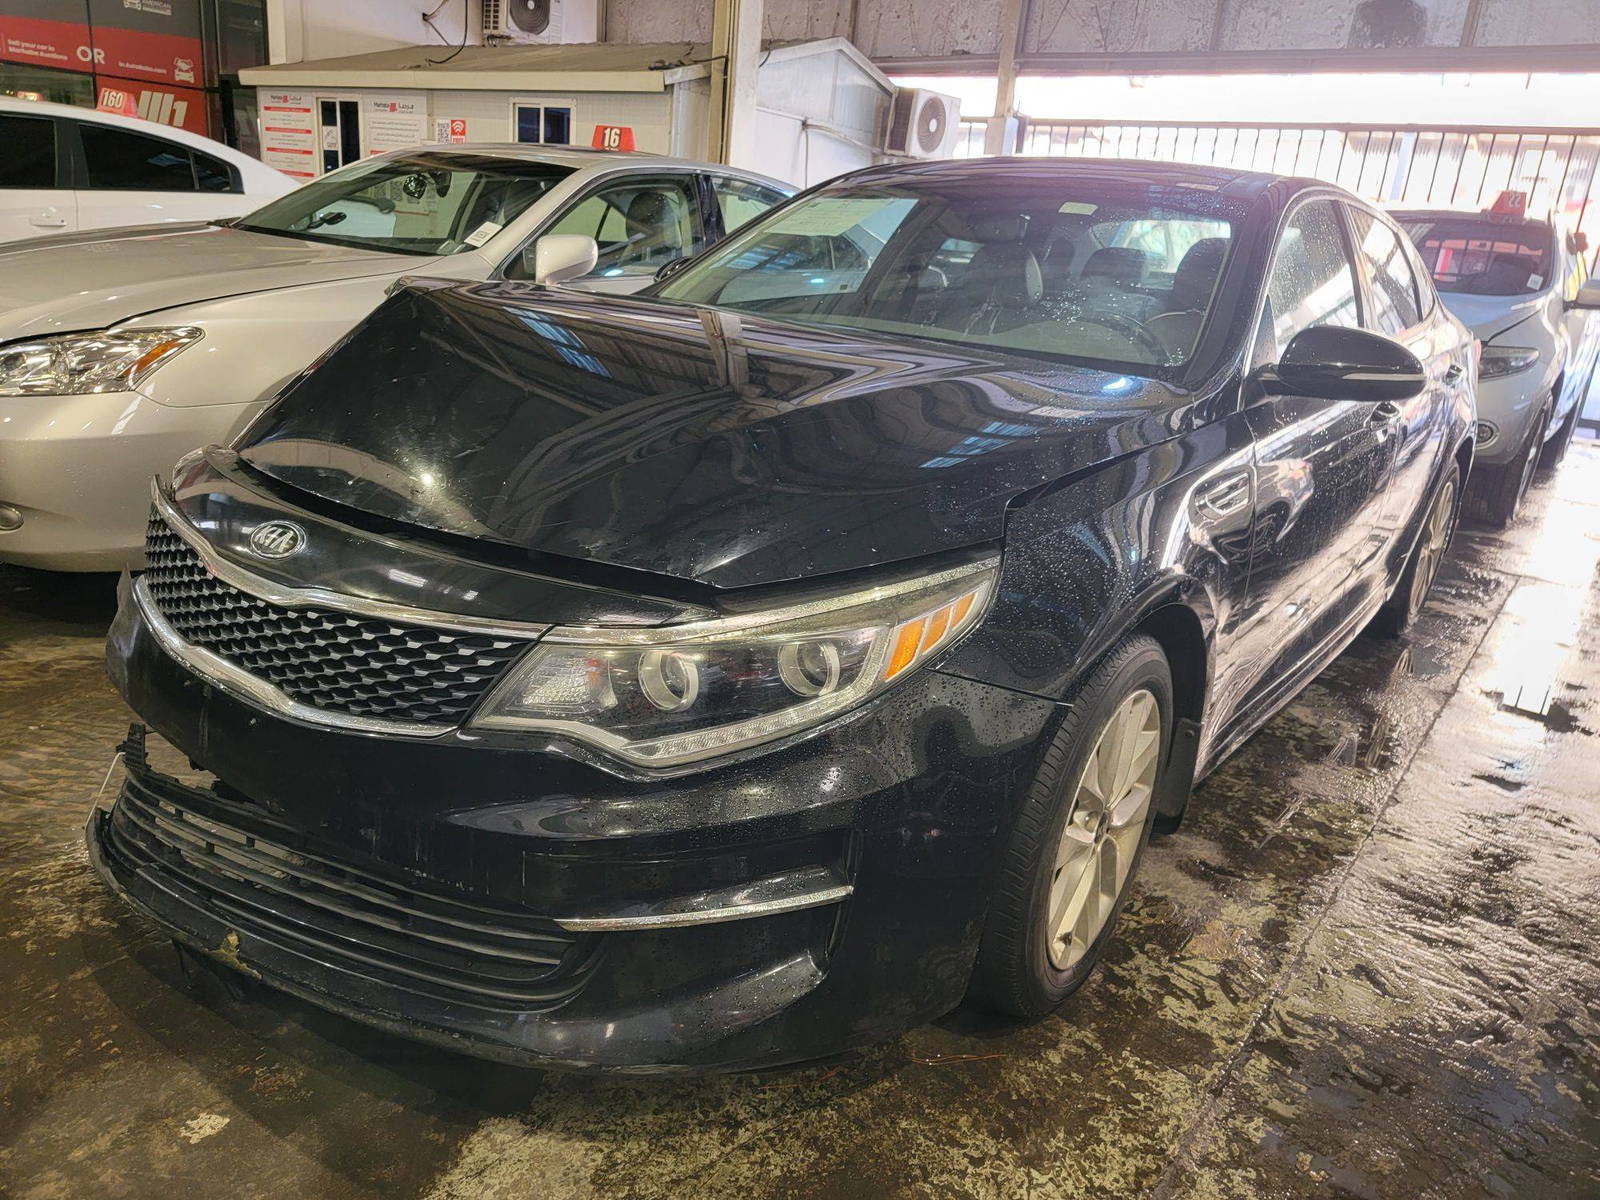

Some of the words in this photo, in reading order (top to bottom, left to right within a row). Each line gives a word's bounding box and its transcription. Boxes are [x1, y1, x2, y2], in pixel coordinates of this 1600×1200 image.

[76, 46, 105, 64] OR
[103, 91, 124, 109] 160
[603, 127, 621, 148] 16
[254, 525, 294, 553] KIA
